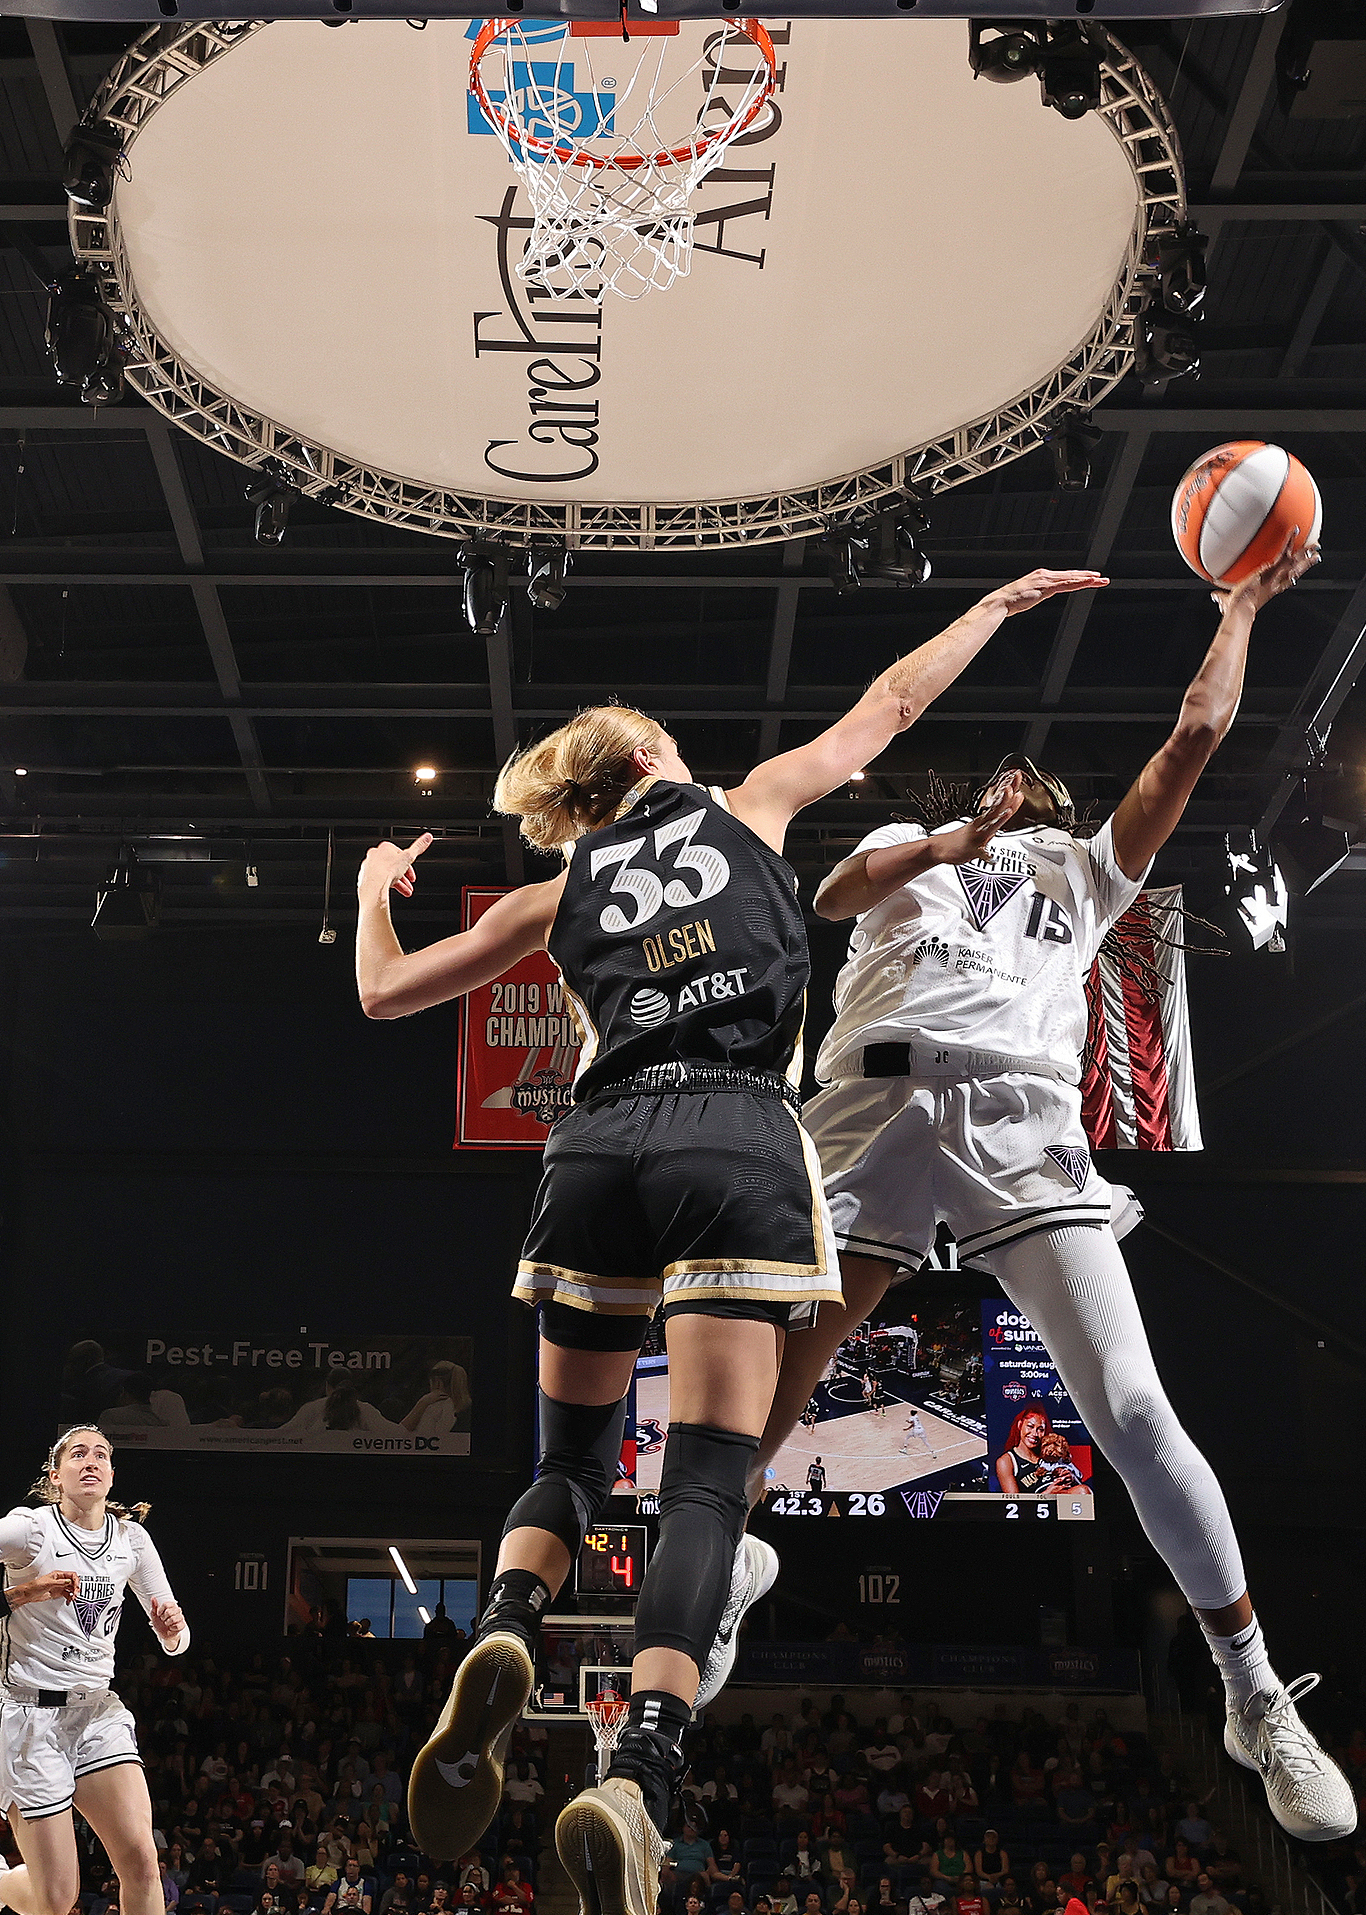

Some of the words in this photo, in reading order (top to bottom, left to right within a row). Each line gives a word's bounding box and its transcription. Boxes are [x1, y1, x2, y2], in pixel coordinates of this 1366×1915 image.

[999, 847, 1028, 862] STATE
[590, 807, 732, 934] 33
[1023, 890, 1074, 945] 15
[642, 918, 717, 973] OLSEN
[957, 948, 994, 965] KAISER
[955, 959, 1028, 987] PERMANENTE
[490, 982, 540, 1014] 2019
[546, 983, 569, 1013] W
[677, 968, 749, 1013] AT&T
[486, 1016, 581, 1047] CHAMPIO
[517, 1087, 571, 1107] mystic
[146, 1338, 302, 1369] Pest-Free
[308, 1341, 391, 1370] Team
[999, 1359, 1038, 1370] saturday,
[771, 1497, 823, 1516] 42.3
[848, 1493, 886, 1516] 26
[1005, 1503, 1019, 1519] 2
[1036, 1503, 1050, 1519] 5
[1071, 1502, 1082, 1515] 5
[788, 1491, 807, 1499] 1ST
[584, 1533, 628, 1552] 42.1
[234, 1561, 269, 1590] 101
[610, 1555, 634, 1588] 4
[79, 1582, 115, 1600] LKYRIES
[858, 1574, 901, 1604] 102
